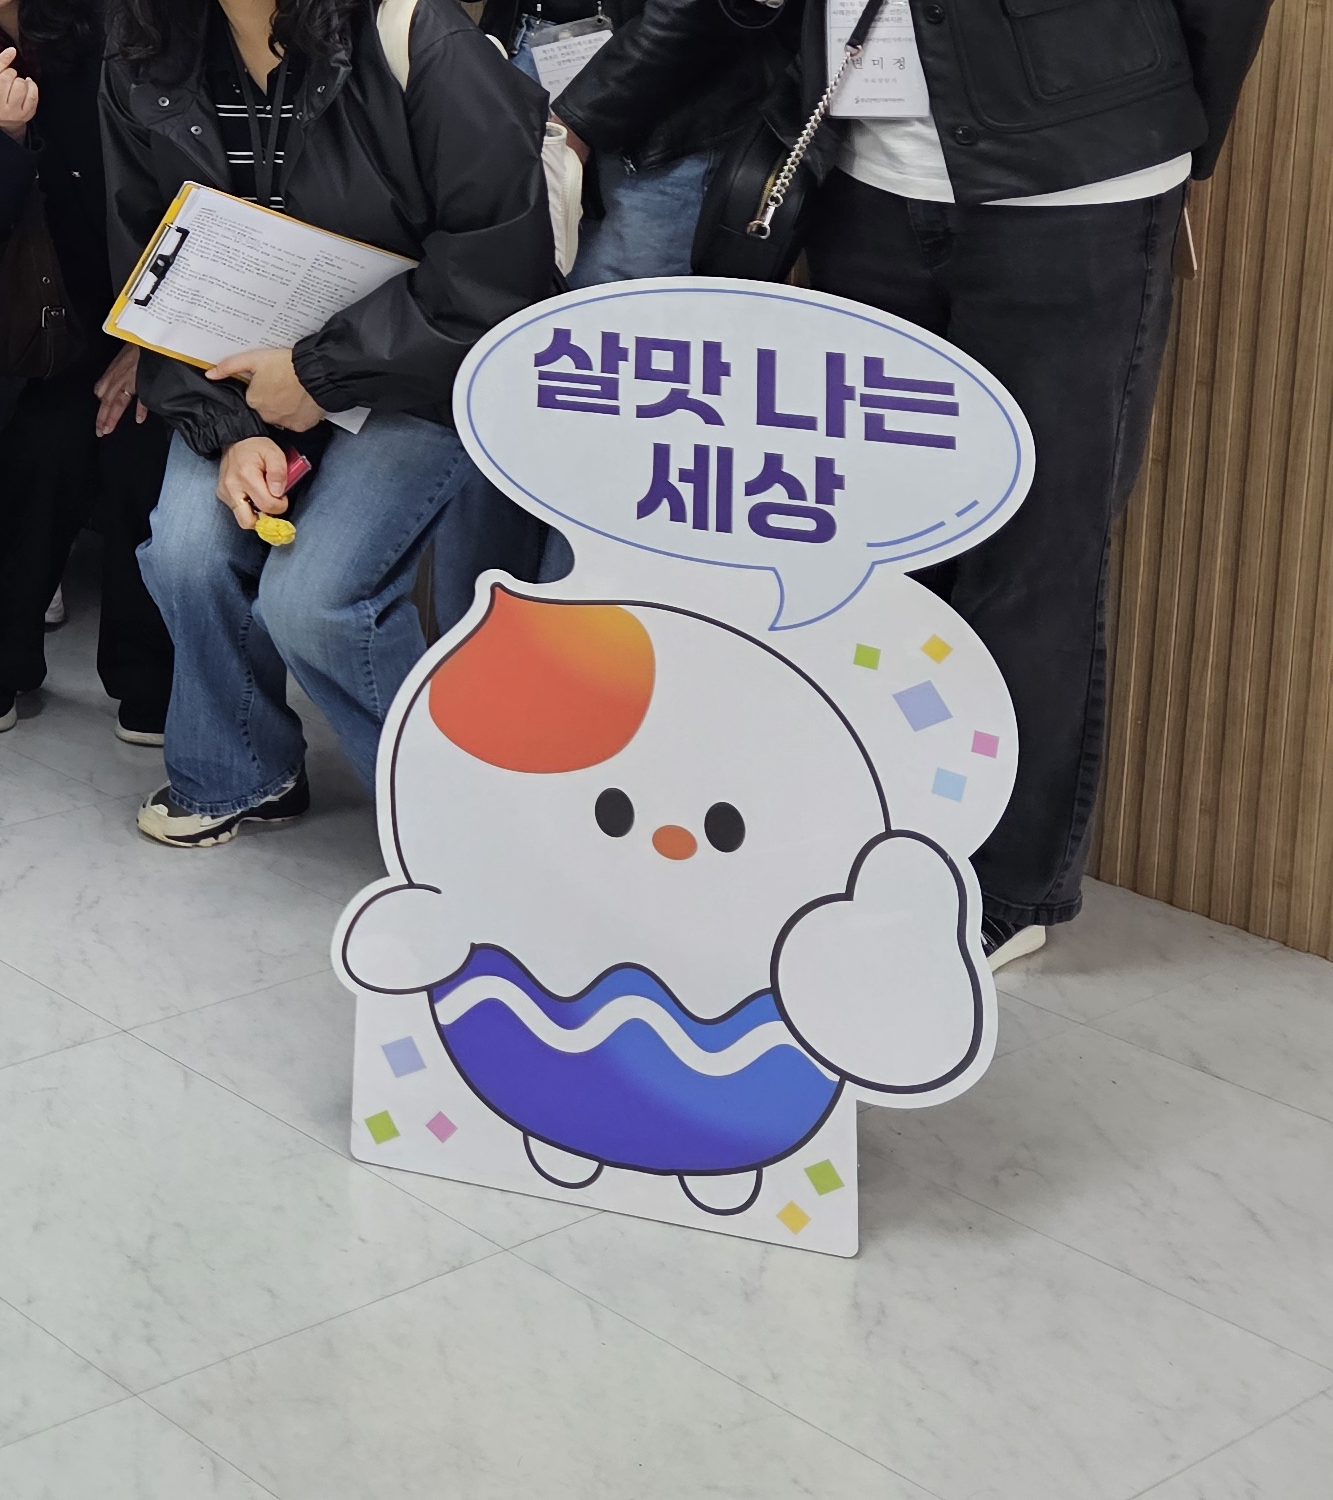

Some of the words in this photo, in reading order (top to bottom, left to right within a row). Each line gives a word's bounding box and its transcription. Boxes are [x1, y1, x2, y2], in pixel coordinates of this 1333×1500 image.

[534, 327, 731, 427] 살맛
[756, 347, 960, 450] 나는
[636, 442, 845, 544] 세상
